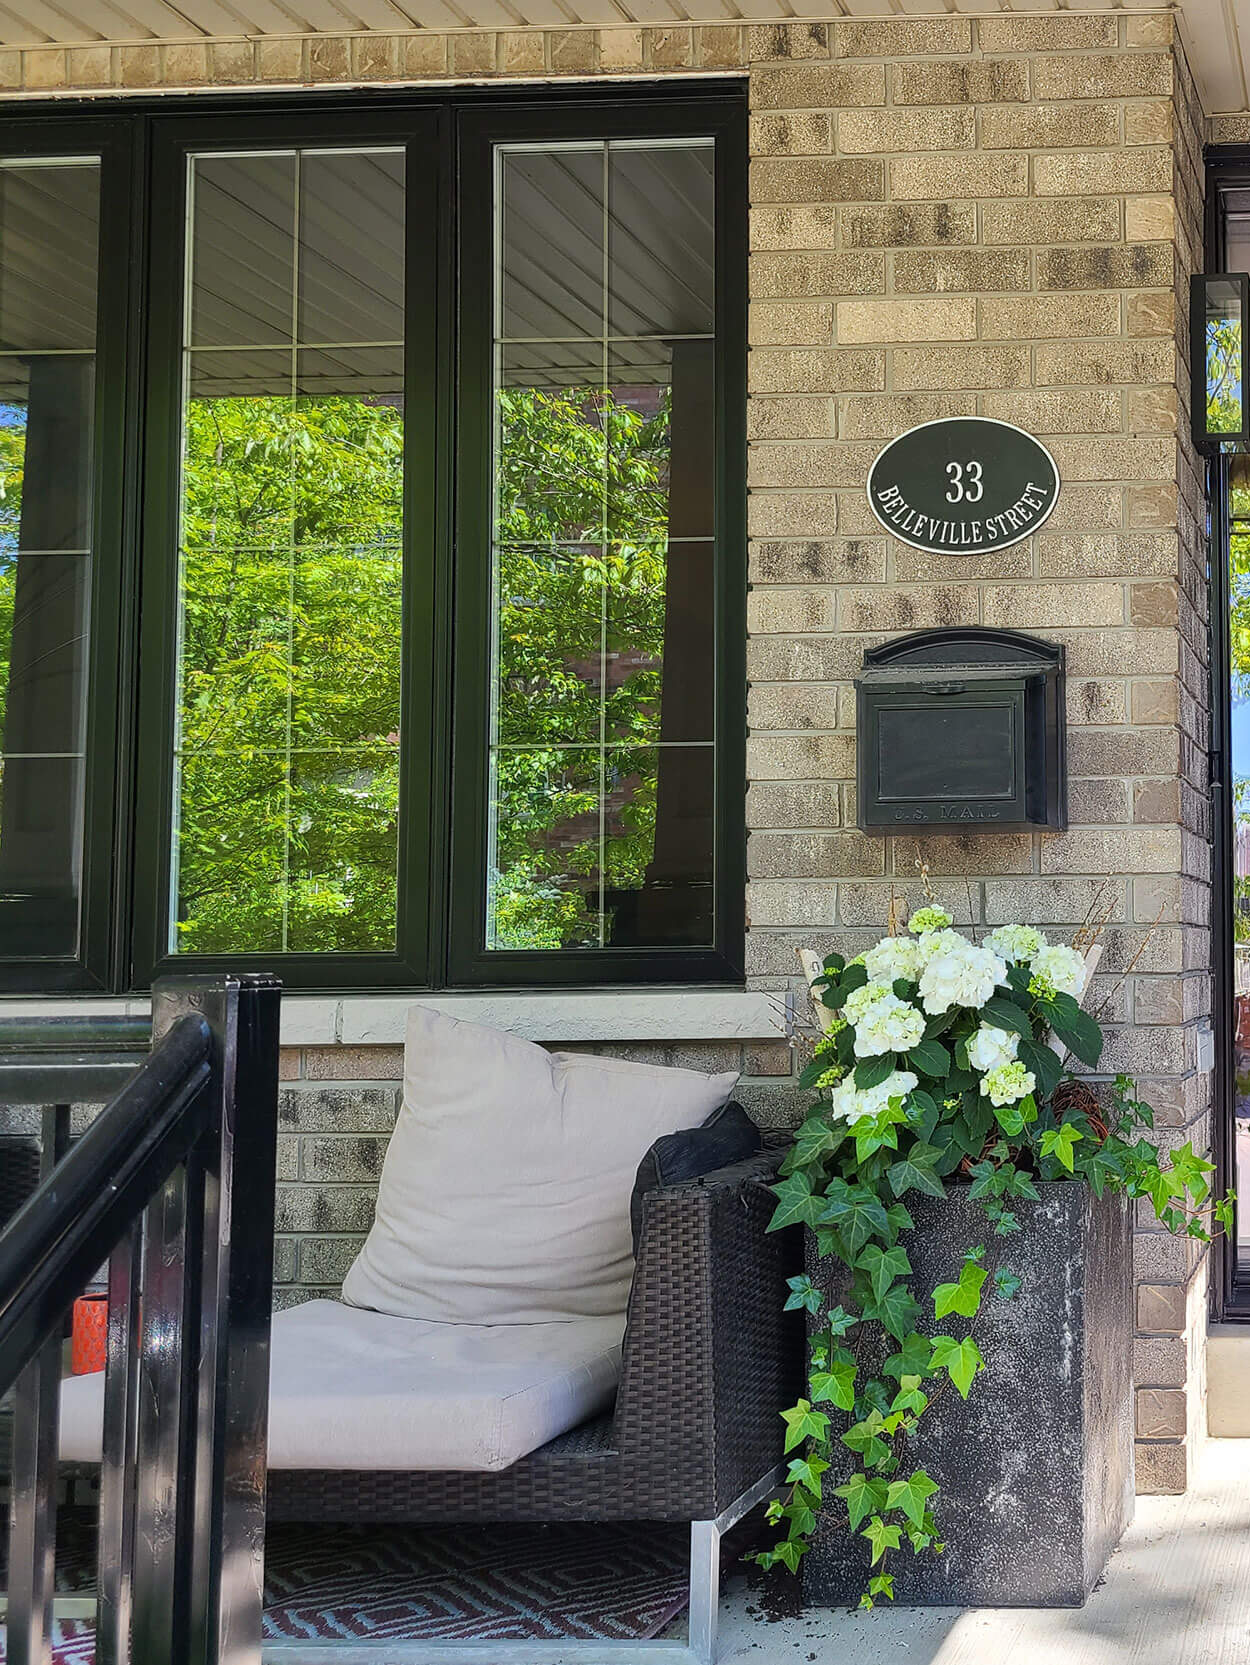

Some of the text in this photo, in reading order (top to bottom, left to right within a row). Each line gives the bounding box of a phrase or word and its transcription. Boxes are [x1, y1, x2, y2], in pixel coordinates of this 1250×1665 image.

[946, 461, 984, 503] 33
[877, 482, 1048, 545] BELLEVILLE STREET
[940, 804, 1001, 819] MAIL
